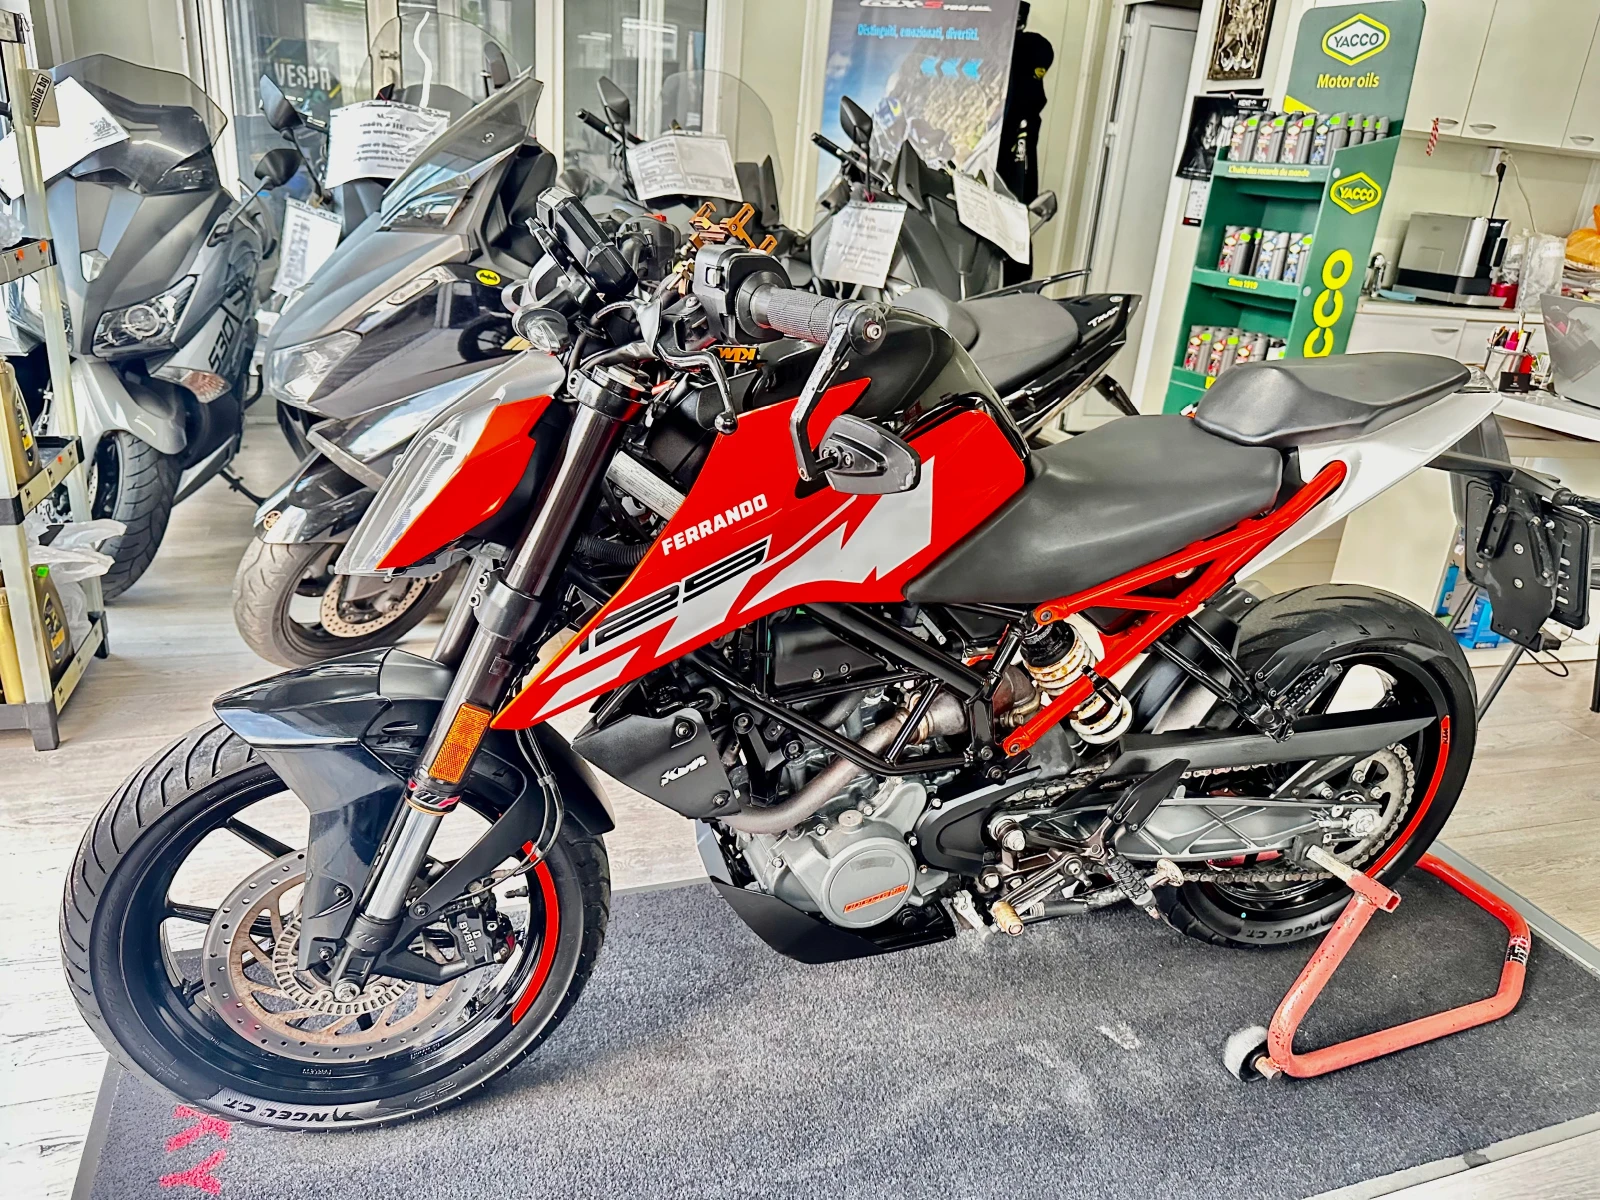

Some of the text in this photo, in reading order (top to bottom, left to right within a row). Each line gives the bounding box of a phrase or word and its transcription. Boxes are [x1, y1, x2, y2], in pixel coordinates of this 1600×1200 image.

[900, 26, 943, 41] emozionati,
[945, 27, 979, 41] divertiti.
[1334, 33, 1380, 48] YACCO
[274, 62, 331, 91] VESPA
[1316, 71, 1380, 89] Motor oils
[1257, 167, 1278, 176] records
[1279, 168, 1288, 176] du
[1288, 168, 1310, 177] monde
[1339, 186, 1375, 201] YACCO
[208, 314, 235, 374] 530
[661, 493, 768, 556] FERRANDO
[579, 537, 770, 655] 125
[458, 921, 477, 953] BYBRE
